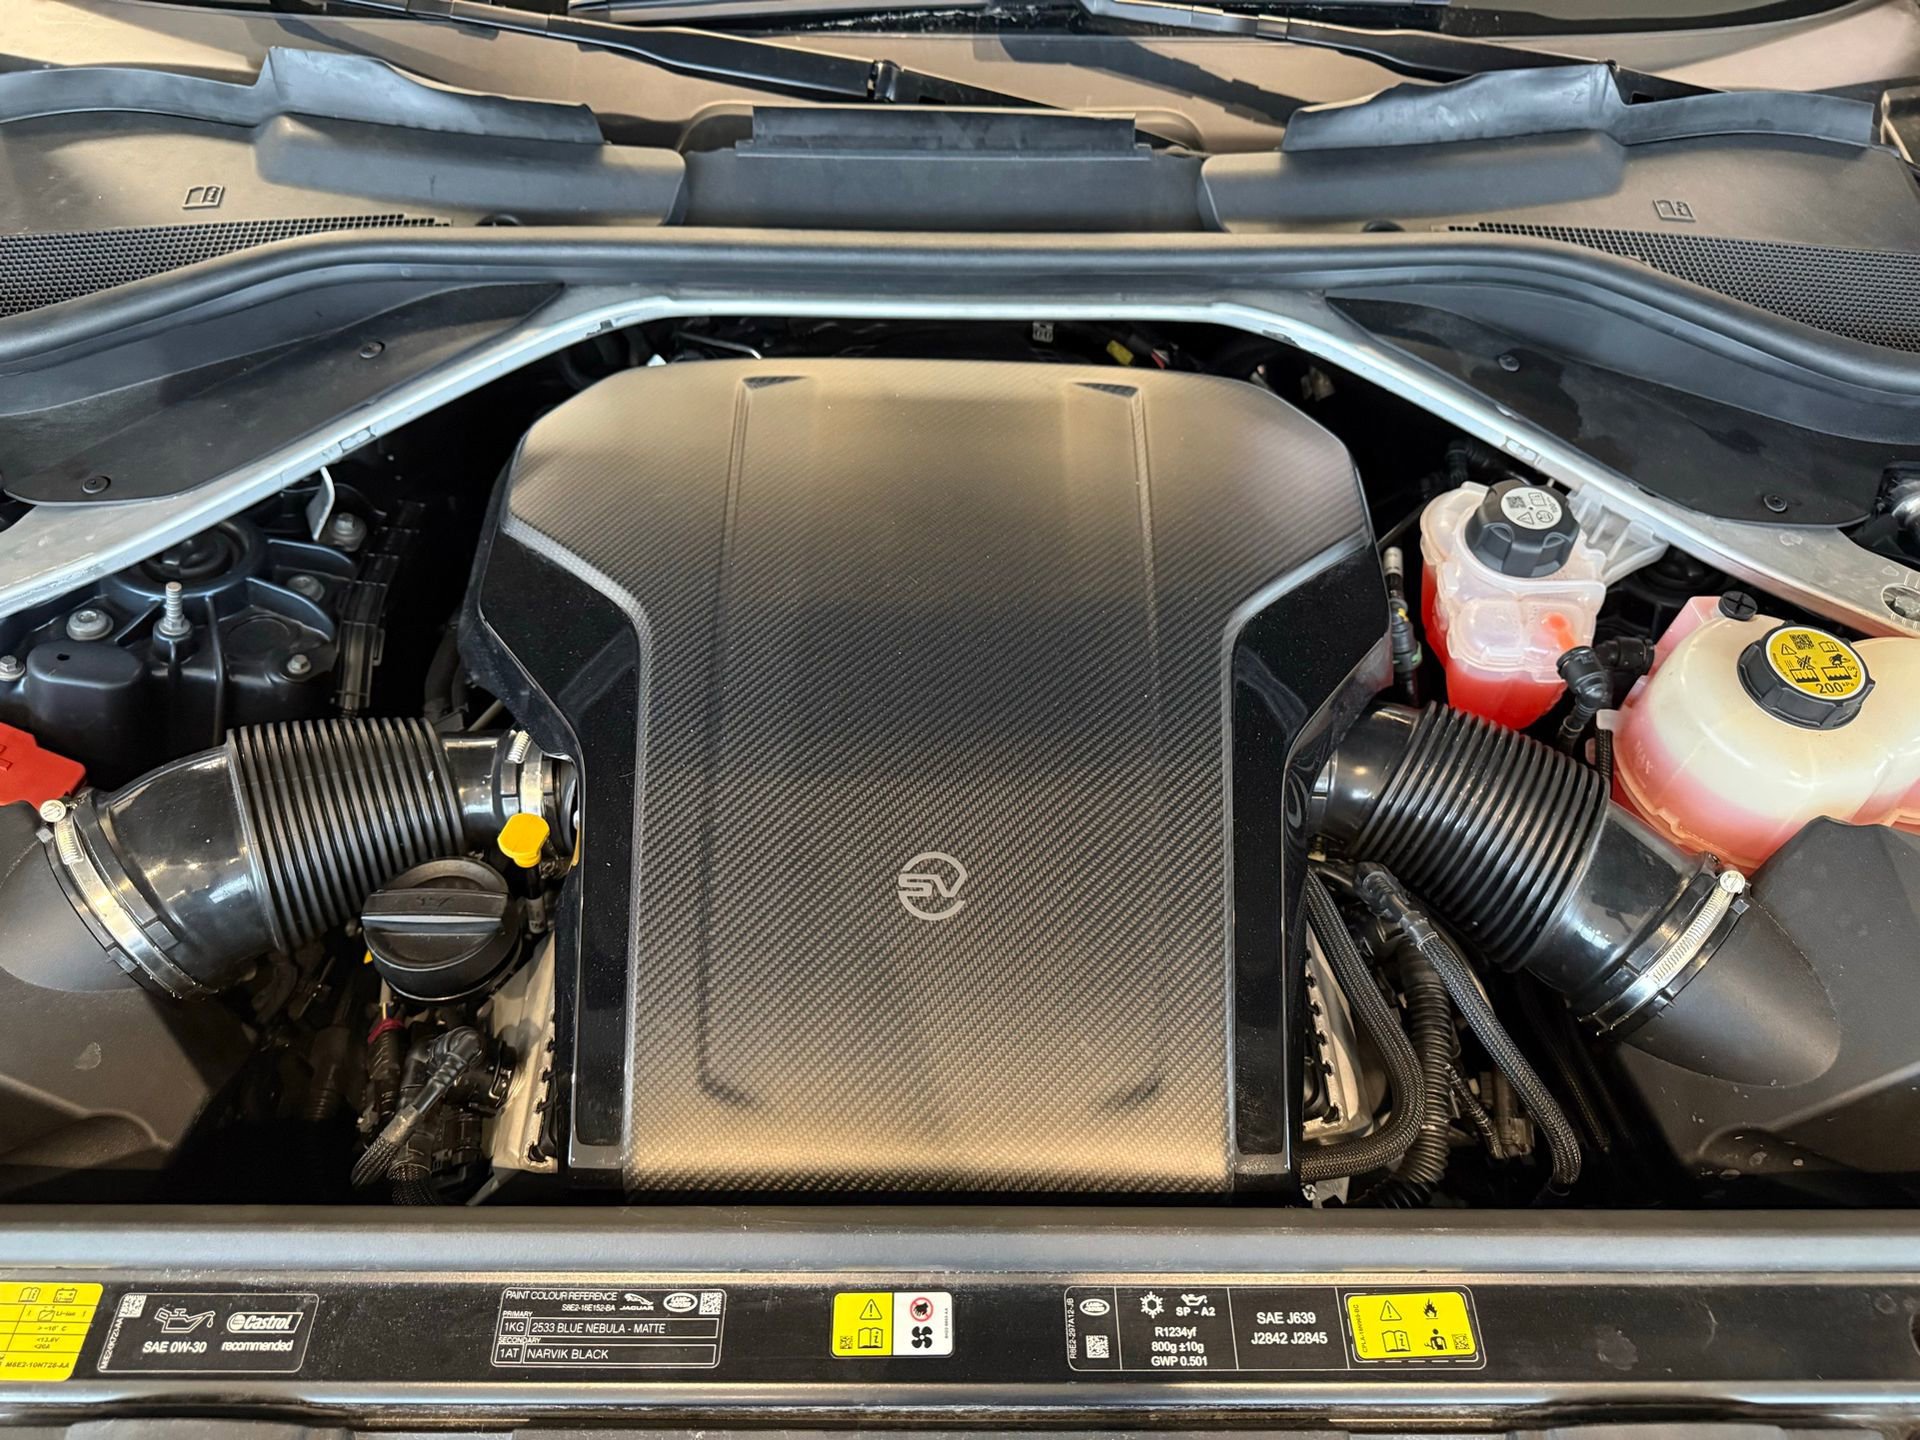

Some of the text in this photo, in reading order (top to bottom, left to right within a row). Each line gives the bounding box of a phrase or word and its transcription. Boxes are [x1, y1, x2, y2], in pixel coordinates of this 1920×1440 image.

[1815, 682, 1844, 694] 200
[505, 1290, 618, 1301] PAINT COLOUR REFERENCE
[1176, 1306, 1191, 1316] SP
[1201, 1306, 1216, 1316] A2
[243, 1315, 292, 1329] Castrol
[1256, 1312, 1317, 1325] SAE J639
[504, 1322, 525, 1332] 1KG
[531, 1322, 555, 1333] 2533
[557, 1323, 584, 1333] BLUE
[585, 1323, 626, 1334] NEBULA
[633, 1324, 666, 1334] MATTE
[1155, 1327, 1197, 1338] R1234yf
[1251, 1332, 1328, 1345] J2842 J2845
[142, 1341, 208, 1353] SAE 0W-30
[221, 1340, 294, 1351] recommended
[1151, 1341, 1205, 1354] 800g ±10g
[500, 1348, 520, 1358] 1AT
[526, 1349, 609, 1359] NARVIK BLACK
[1151, 1356, 1208, 1367] GWP 0.501
